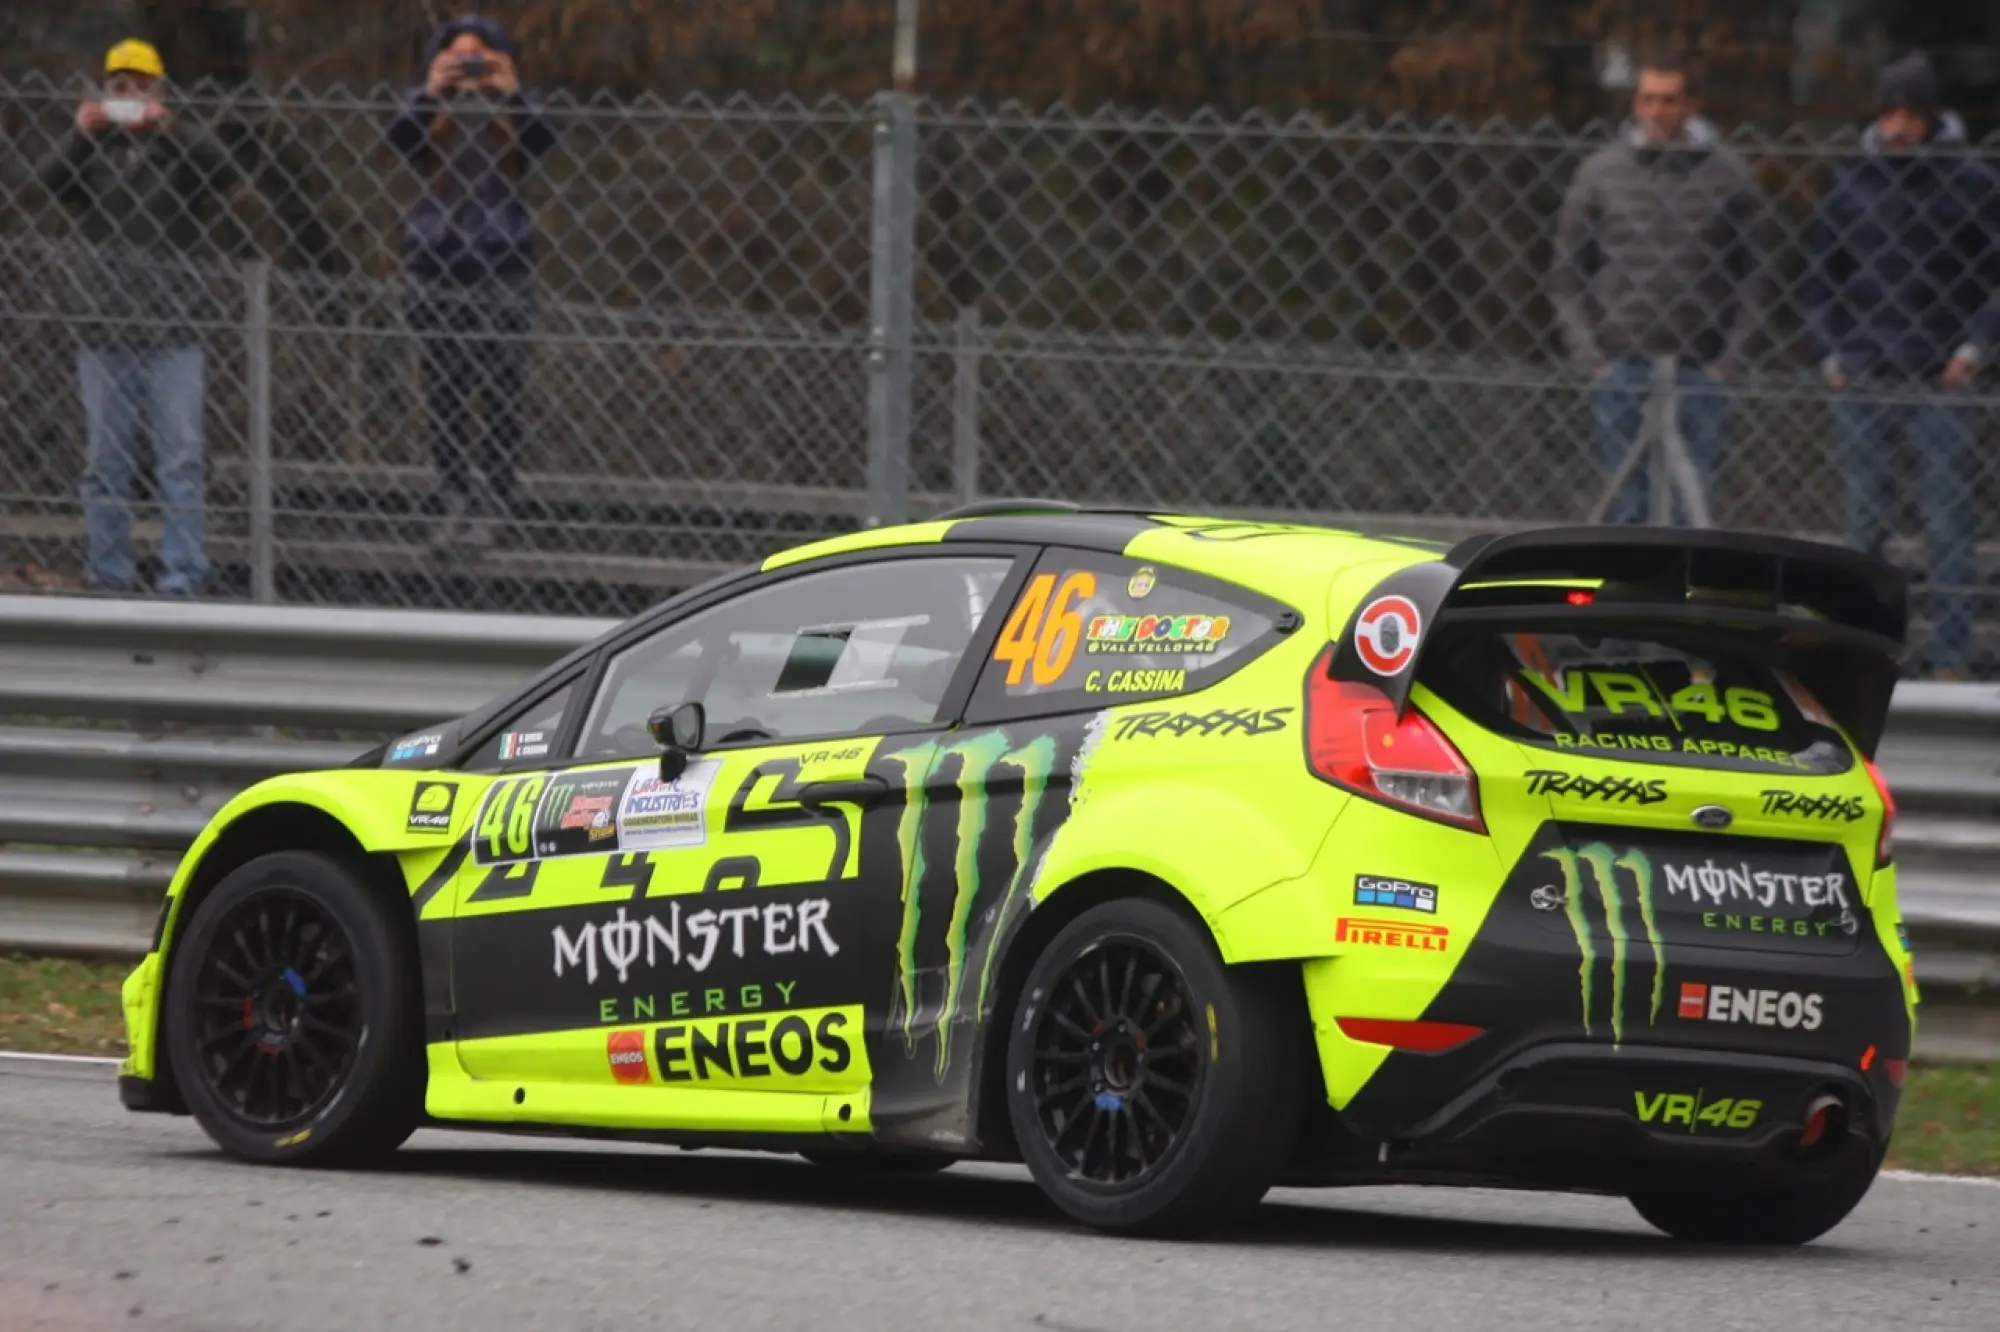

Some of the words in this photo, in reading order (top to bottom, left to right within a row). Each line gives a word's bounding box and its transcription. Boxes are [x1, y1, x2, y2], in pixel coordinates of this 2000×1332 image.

[994, 572, 1096, 685] 46
[1086, 616, 1136, 641] THE
[1135, 614, 1230, 641] DOCTOR
[1085, 671, 1101, 693] C.
[1107, 670, 1185, 692] CASSINA
[1114, 707, 1294, 741] TRAXXAS
[1554, 732, 1671, 751] RACING
[1524, 770, 1668, 804] TRAXXAS
[480, 779, 546, 858] 46
[1760, 790, 1865, 820] TRAXXAS
[1358, 878, 1434, 898] GoPro
[1664, 861, 1848, 907] MONSTER
[552, 899, 840, 984] MONSTER
[1336, 918, 1449, 952] PIRELLI
[1703, 913, 1828, 937] ENERGY
[600, 981, 797, 1023] ENERGY
[1707, 984, 1824, 1031] ENEOS
[655, 1013, 851, 1082] ENEOS
